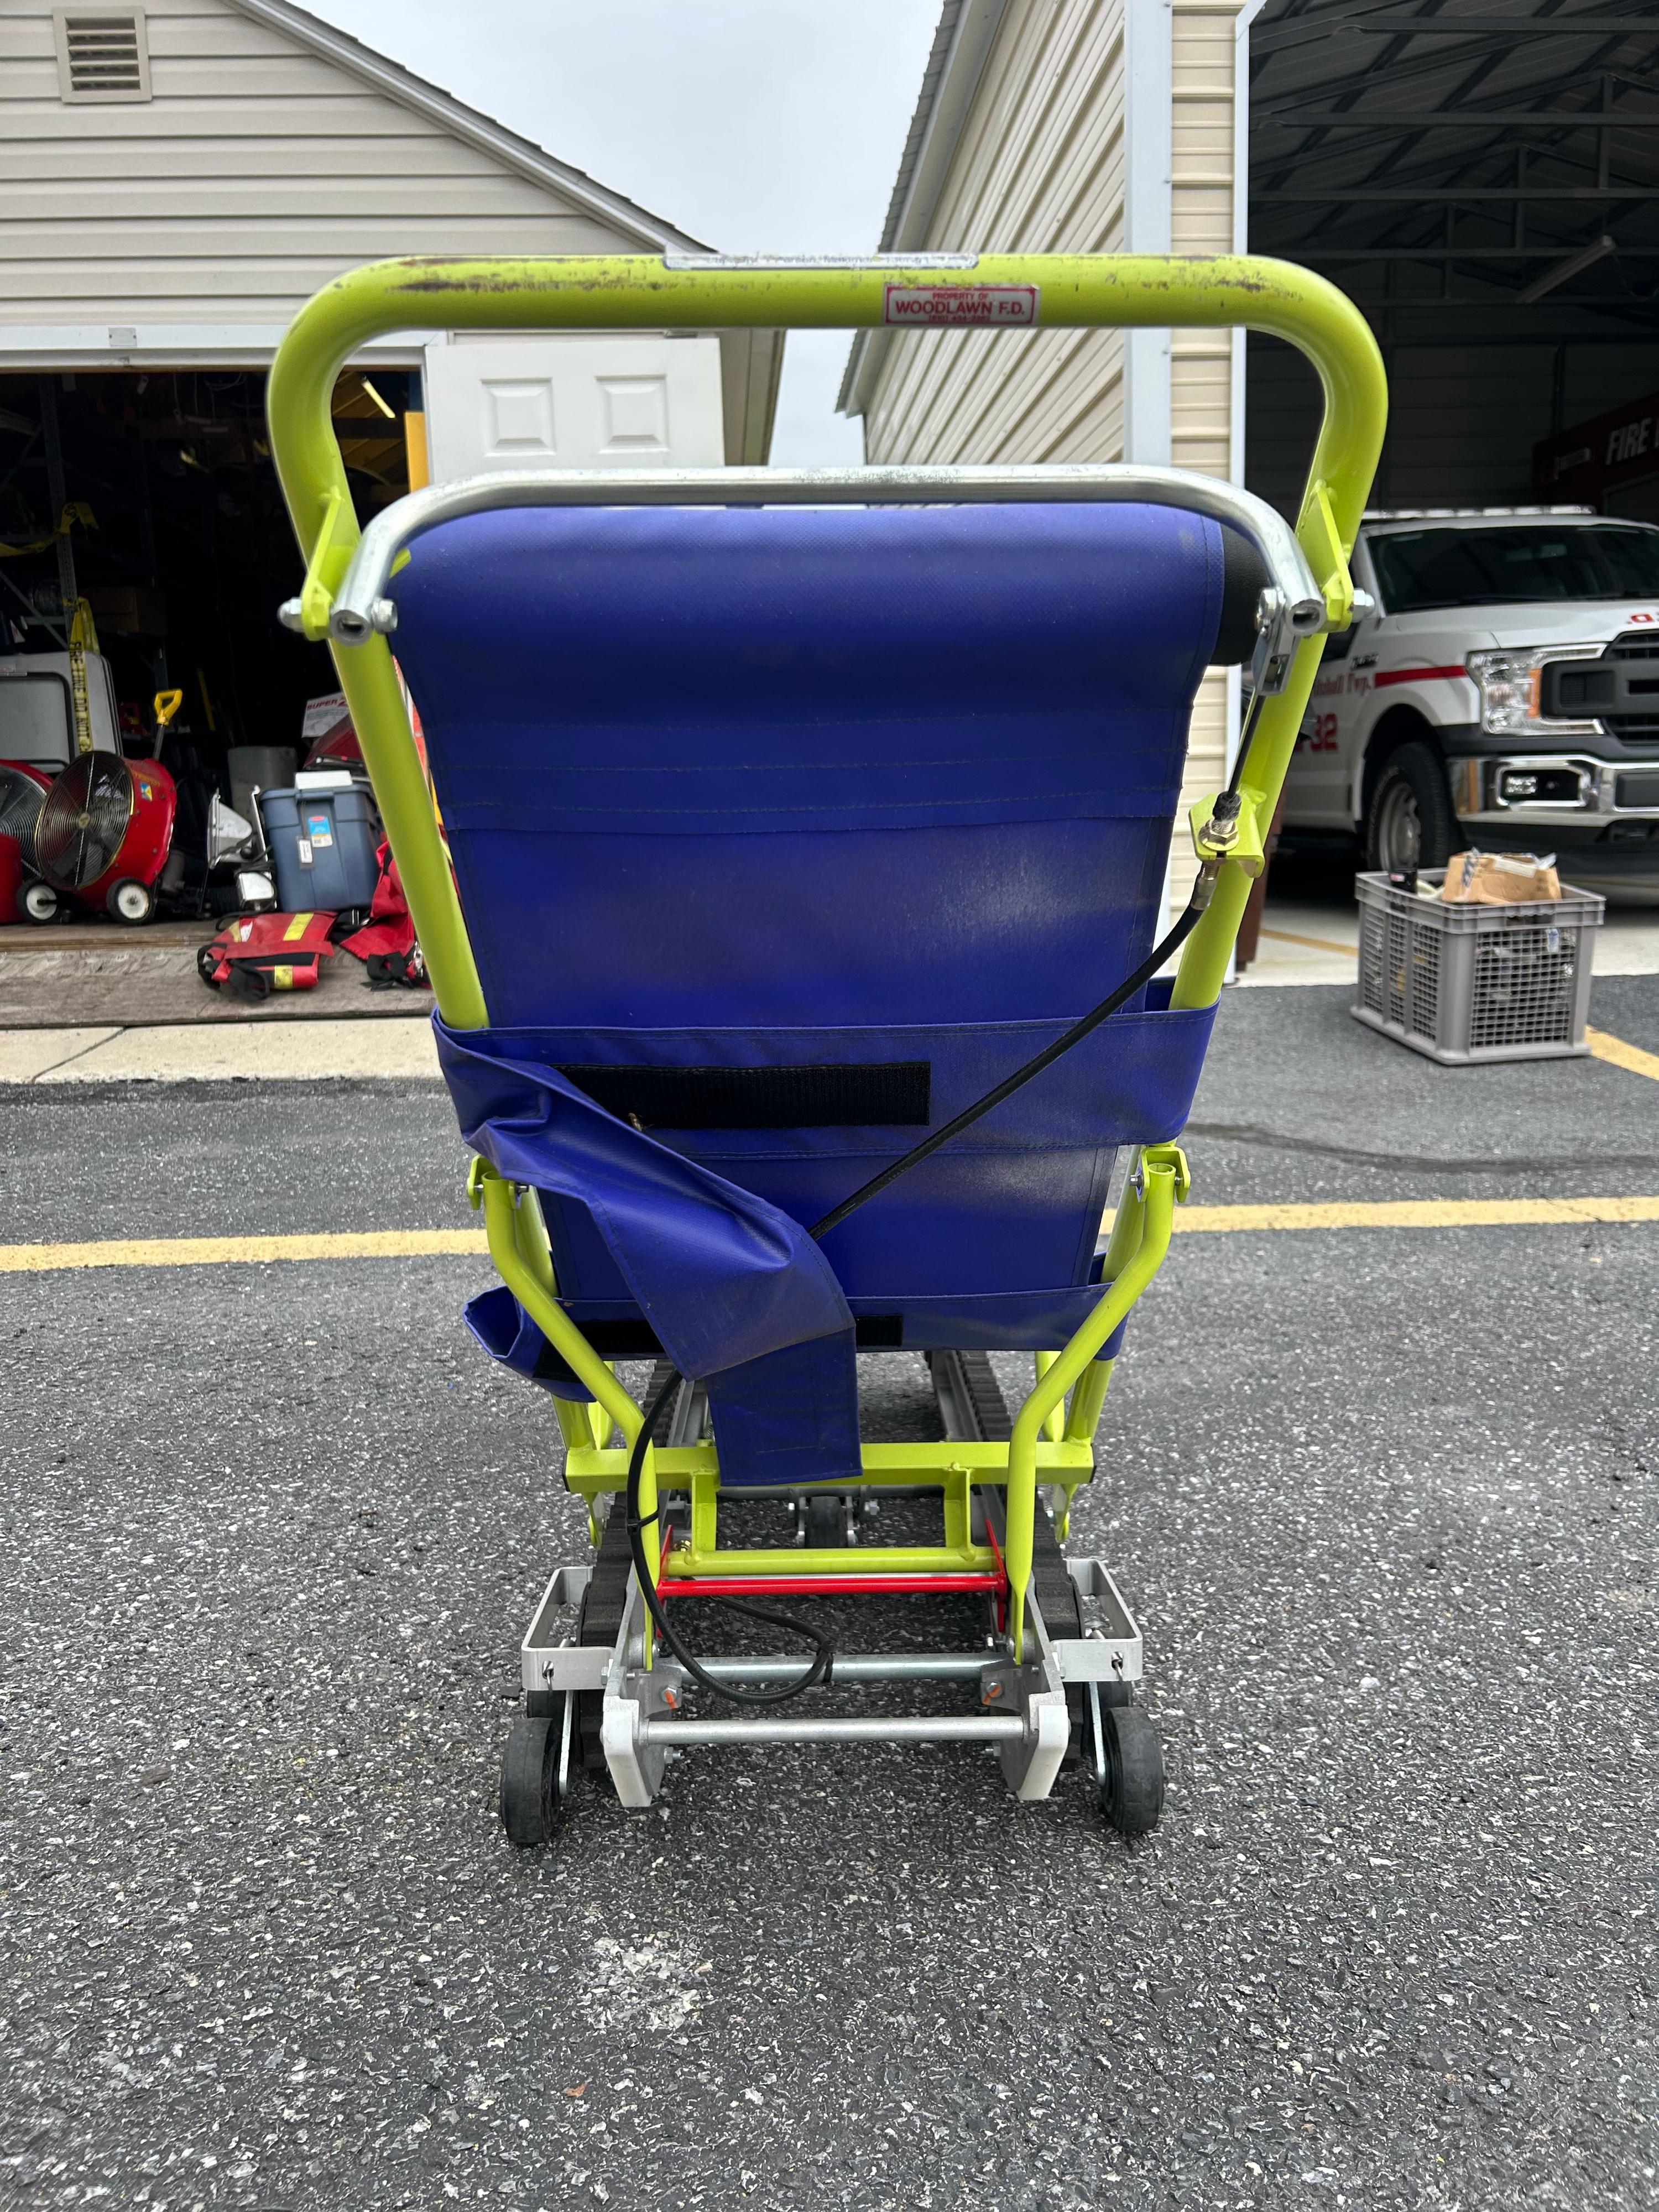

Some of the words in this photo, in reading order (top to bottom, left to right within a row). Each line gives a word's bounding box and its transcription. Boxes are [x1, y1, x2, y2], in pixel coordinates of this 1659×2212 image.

[895, 300, 993, 314] WOODLAWN
[999, 301, 1025, 315] F.D.
[1605, 417, 1652, 465] FIRE
